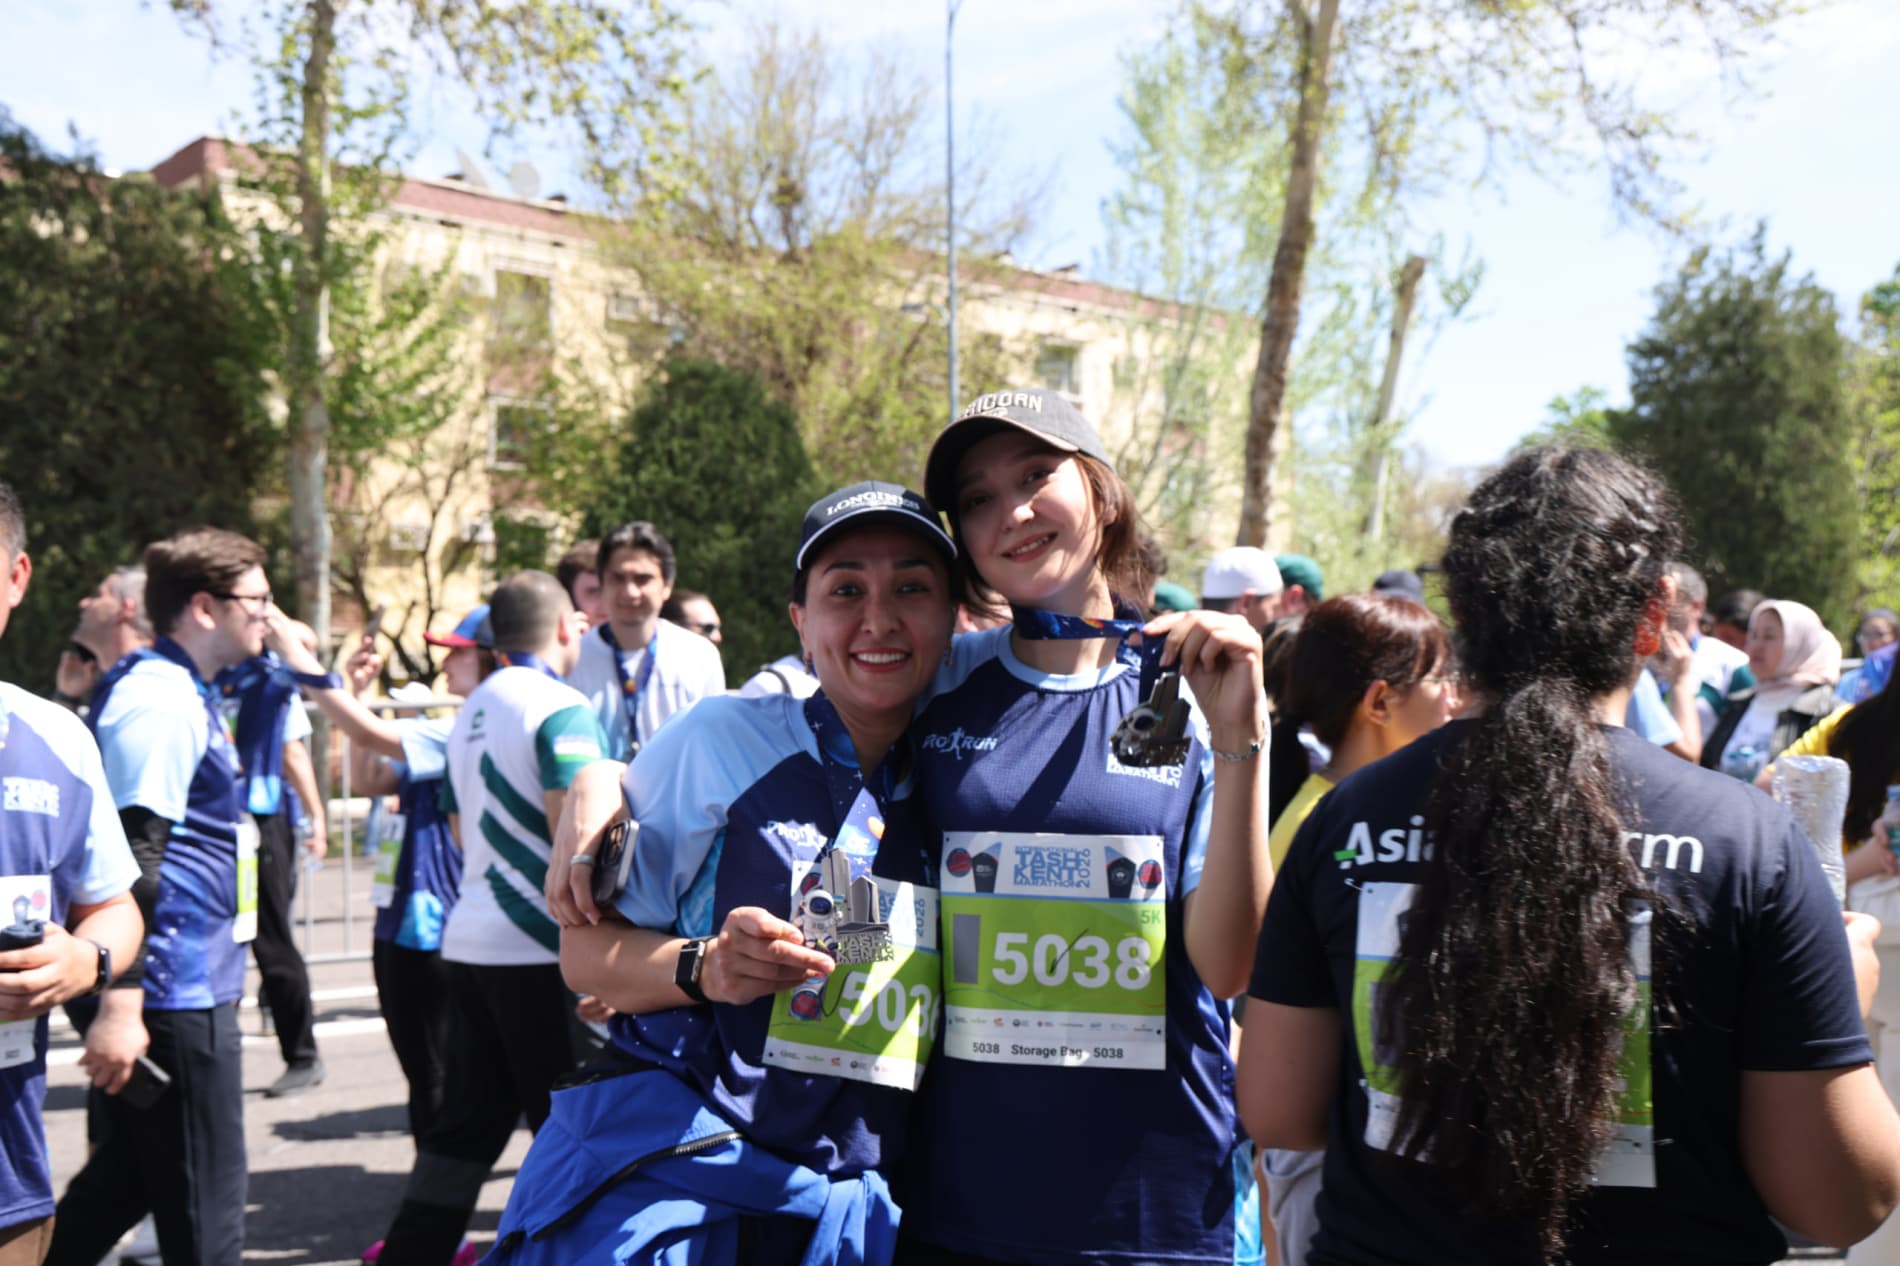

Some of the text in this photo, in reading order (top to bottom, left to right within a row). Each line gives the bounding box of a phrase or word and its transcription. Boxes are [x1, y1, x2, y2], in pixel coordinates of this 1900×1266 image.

[1015, 850, 1080, 869] TASH
[1079, 848, 1091, 888] 2026
[1014, 864, 1078, 882] KENT
[1141, 910, 1161, 924] 5K
[992, 932, 1152, 990] 5038
[972, 1042, 1124, 1060] 5038 Storage Bag 5038
